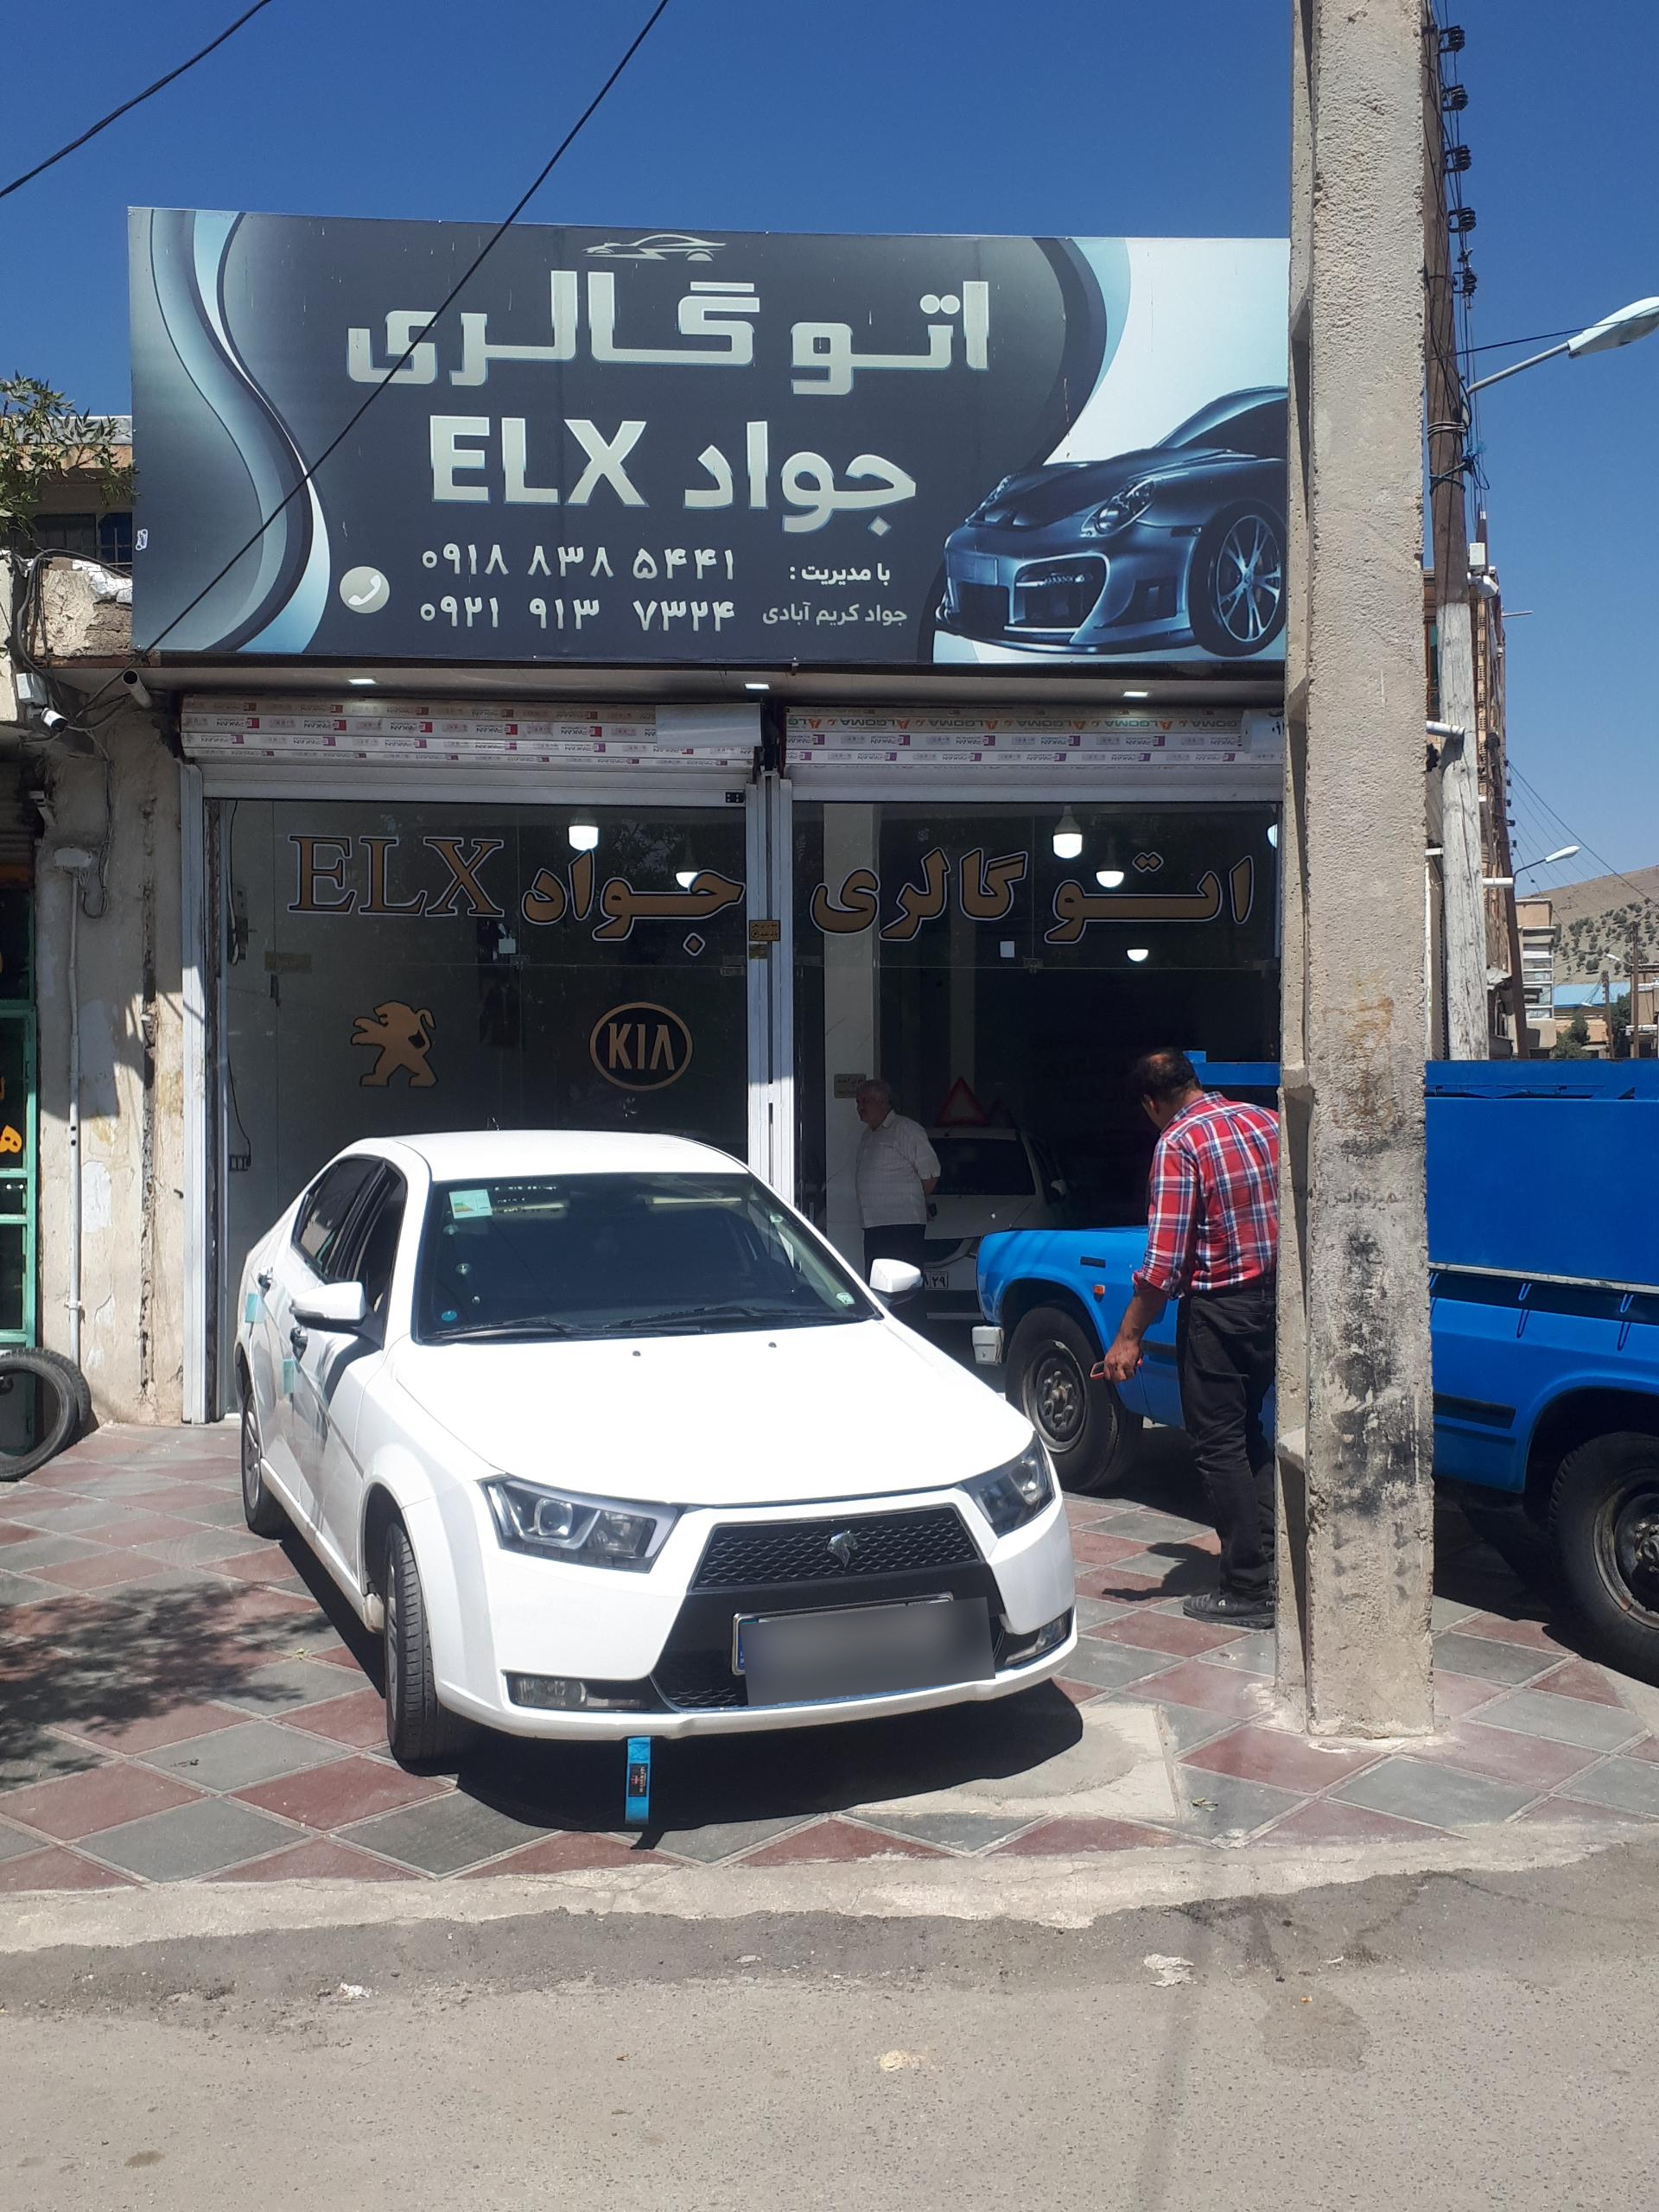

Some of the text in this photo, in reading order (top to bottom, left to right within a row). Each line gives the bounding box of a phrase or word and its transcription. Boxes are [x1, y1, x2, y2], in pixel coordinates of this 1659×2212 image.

[347, 269, 989, 396] اتو گالری
[429, 415, 917, 536] جواد ELX
[422, 543, 734, 580] ۰۹۱۸ ۸۳۸ ۵۴۴۱
[876, 563, 891, 586] با
[420, 595, 734, 632] ۰۹۲۱ ۹۱۳ ۷۳۲۴
[762, 601, 908, 626] جواد کریم آبادی
[288, 833, 747, 957] جواد ELX
[810, 846, 1254, 944] اتو گالری
[607, 1023, 676, 1071] KIA
